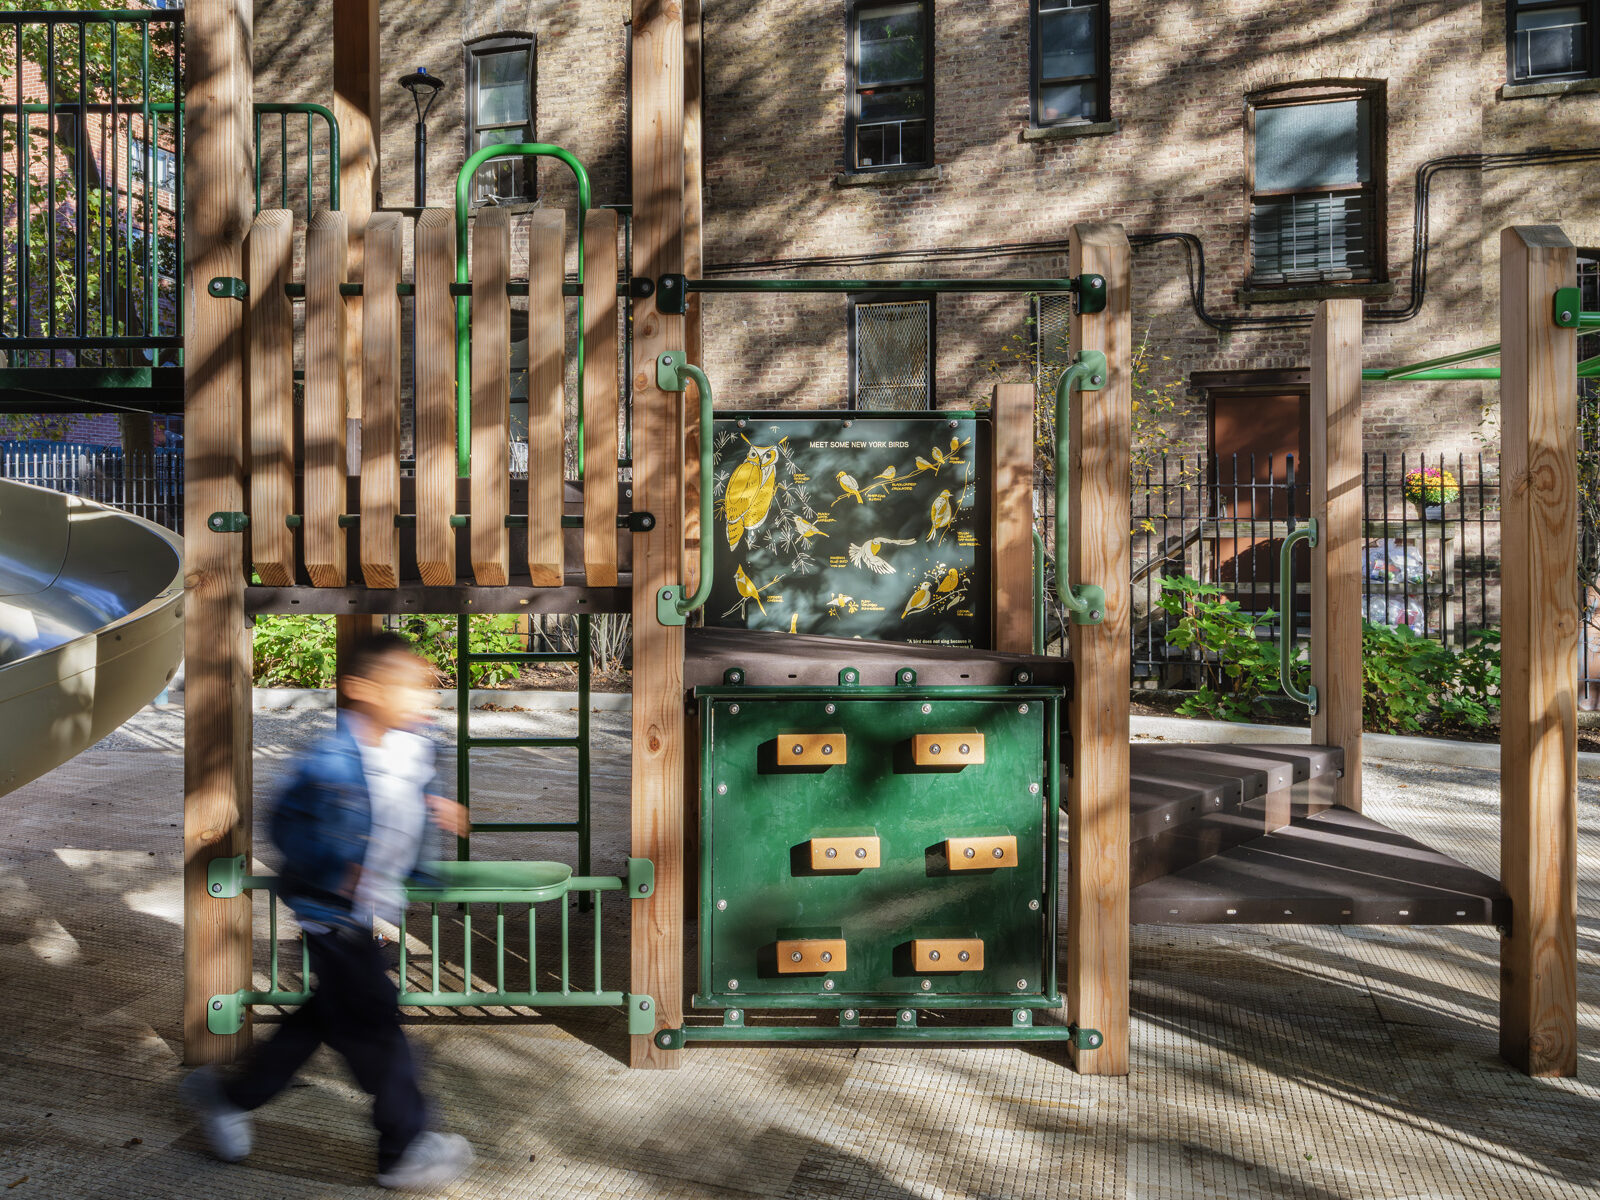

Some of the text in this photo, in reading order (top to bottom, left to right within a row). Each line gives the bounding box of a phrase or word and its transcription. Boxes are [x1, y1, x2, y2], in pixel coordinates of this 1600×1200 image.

[809, 441, 910, 449] MEET SOME NEW YORK BIRDS
